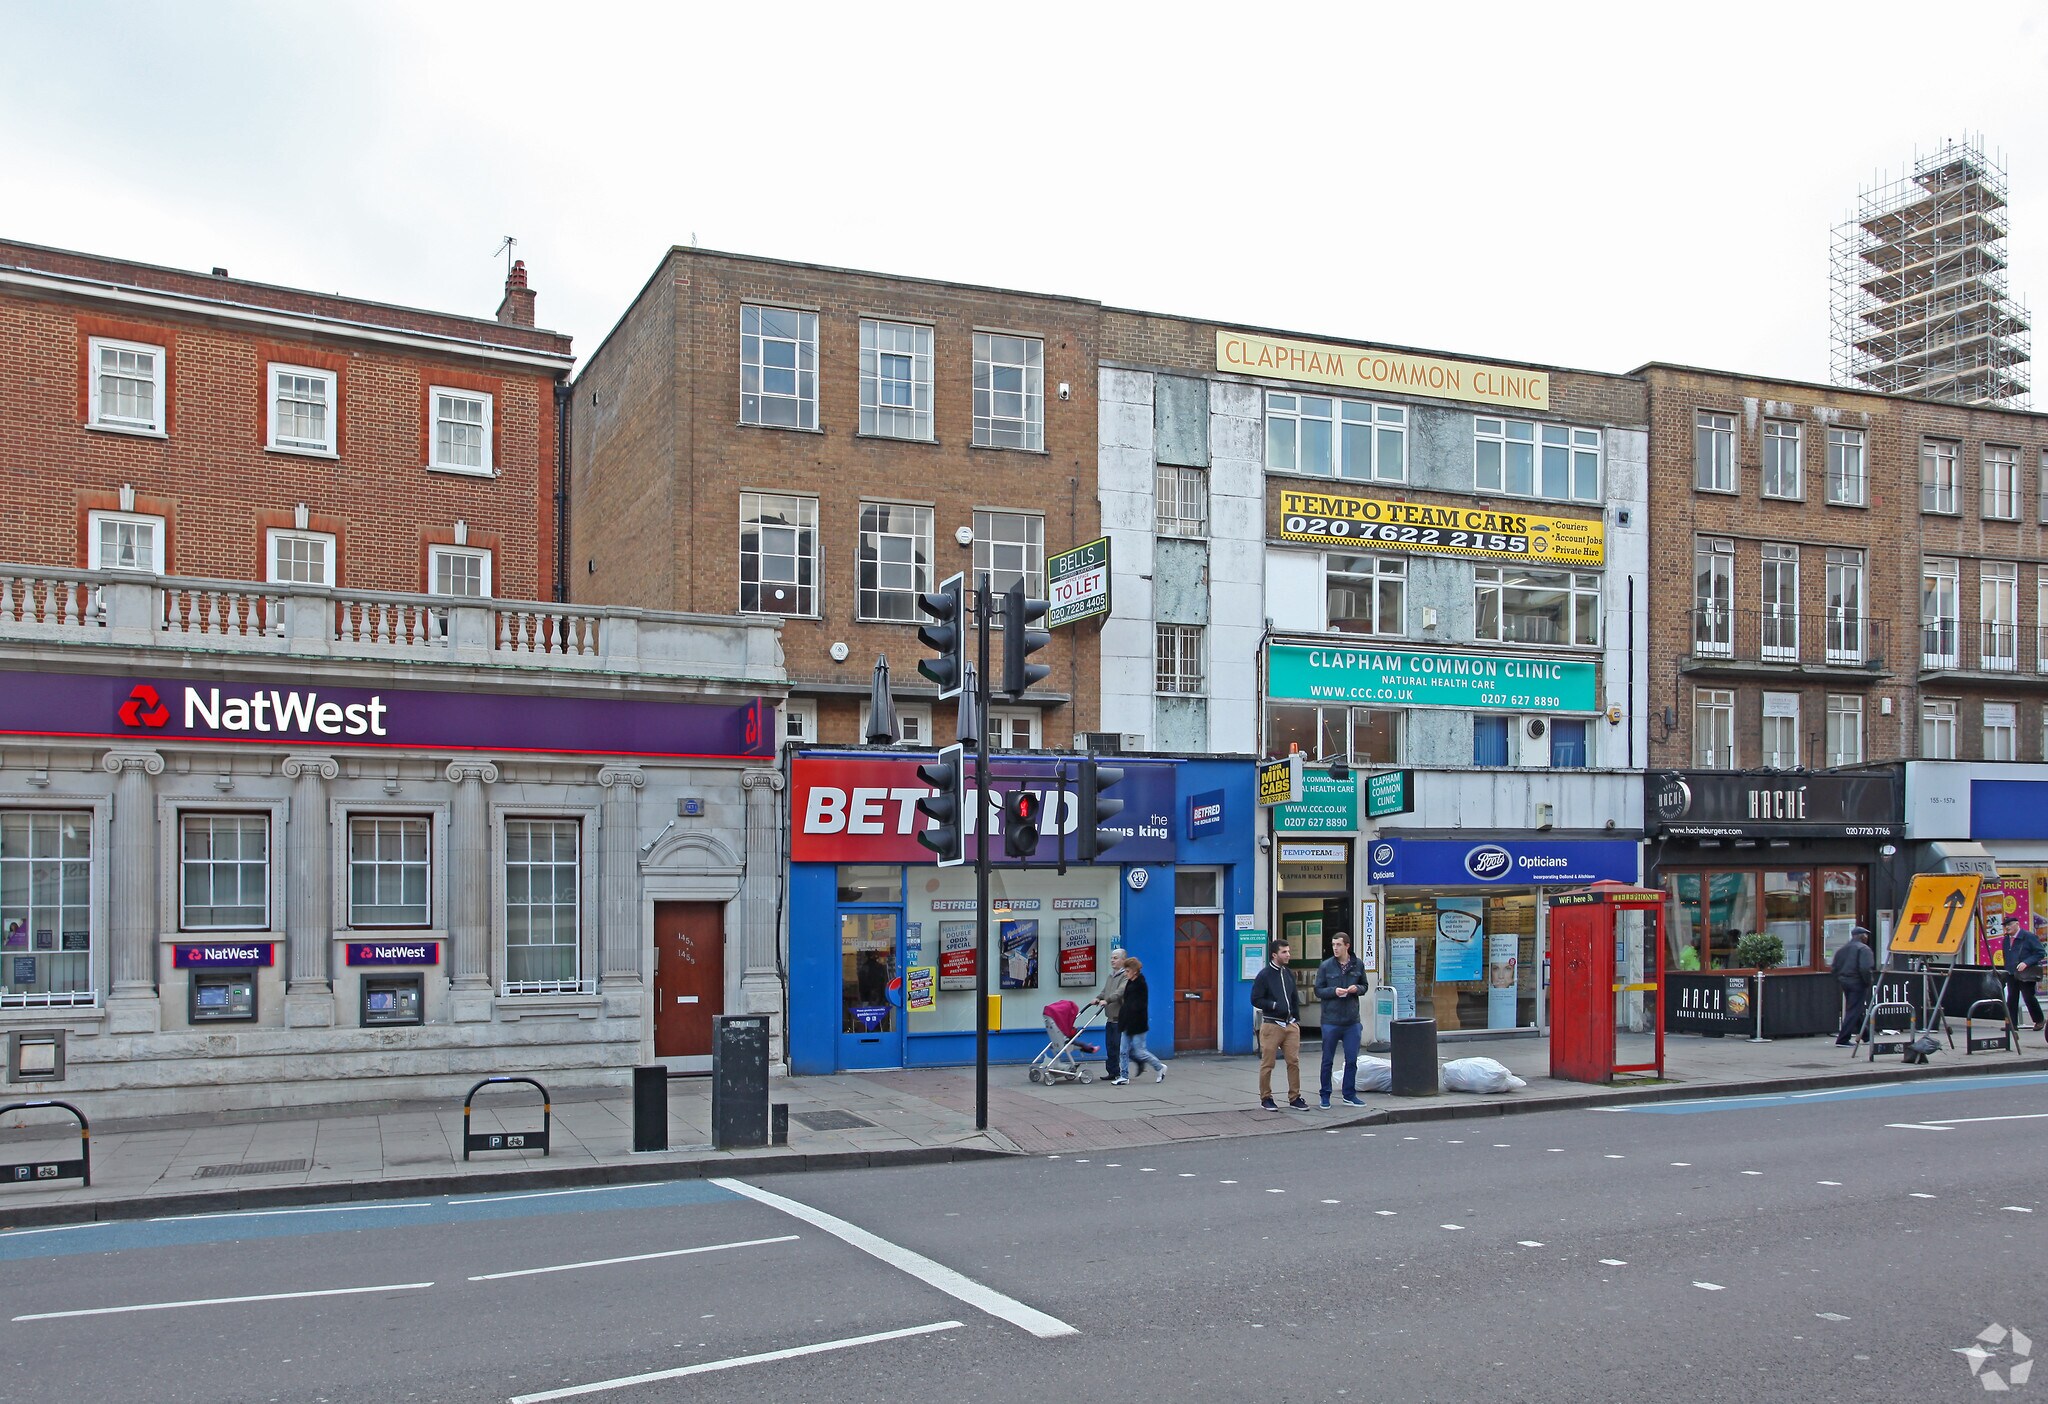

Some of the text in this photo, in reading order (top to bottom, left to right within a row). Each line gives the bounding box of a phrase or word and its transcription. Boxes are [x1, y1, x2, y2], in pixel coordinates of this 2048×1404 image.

[1225, 340, 1541, 401] CLAPHAM COMMON CLINIC
[1285, 494, 1527, 534] TEMPO TEAM CARS
[1555, 521, 1588, 531] Couriers
[1286, 516, 1526, 552] 020 7622 2155
[1555, 533, 1603, 546] Account Jobs
[1555, 545, 1582, 555] Private
[1583, 548, 1599, 557] Hire
[1059, 547, 1095, 573] BELLS
[1055, 584, 1072, 602] TO
[1076, 574, 1100, 595] LET
[1051, 608, 1064, 620] 020
[1067, 601, 1085, 616] 7228
[1086, 594, 1105, 608] 4405
[1309, 651, 1561, 680] CLAPHAM COMMON CLINIC
[1381, 675, 1495, 690] NATURAL HEALTH CARE
[1310, 685, 1413, 700] WWW.CCC.CO.UK
[1481, 693, 1560, 707] 0207 627 8890
[184, 686, 387, 736] NatWest
[1261, 767, 1289, 784] MINI
[1372, 773, 1400, 787] CLAPHAM
[1261, 779, 1290, 796] CABS
[1310, 785, 1336, 793] HEALTH
[1337, 785, 1354, 793] CARE
[1372, 783, 1400, 797] COMMON
[1377, 795, 1395, 807] CLINIC
[1749, 786, 1807, 819] HACHÉ
[1194, 804, 1220, 820] BETFRED
[1285, 805, 1347, 813] WWW.CCC.CO.UK
[1151, 814, 1167, 826] the
[1284, 818, 1348, 827] 0207 627 8890
[1139, 825, 1168, 839] king
[1669, 826, 1890, 837] www.hacheburgers.com 020 7720 7766
[1474, 852, 1568, 871] Boots Opticians
[1373, 871, 1394, 880] Opticians
[2004, 880, 2028, 890] PRICE
[933, 900, 977, 910] BETFRED
[995, 900, 1039, 909] BETFRED
[1054, 899, 1097, 909] BETFRED
[1559, 895, 1586, 904] WiFi here
[946, 930, 971, 939] DOUBLE
[1066, 927, 1090, 936] DOUBLE
[946, 942, 971, 951] SPECIAL
[1066, 939, 1090, 948] SPECIAL
[204, 947, 259, 960] NatWest
[375, 946, 425, 959] NatWest
[1682, 988, 1720, 1010] HACH
[492, 1136, 500, 1147] P
[18, 1167, 28, 1179] P
